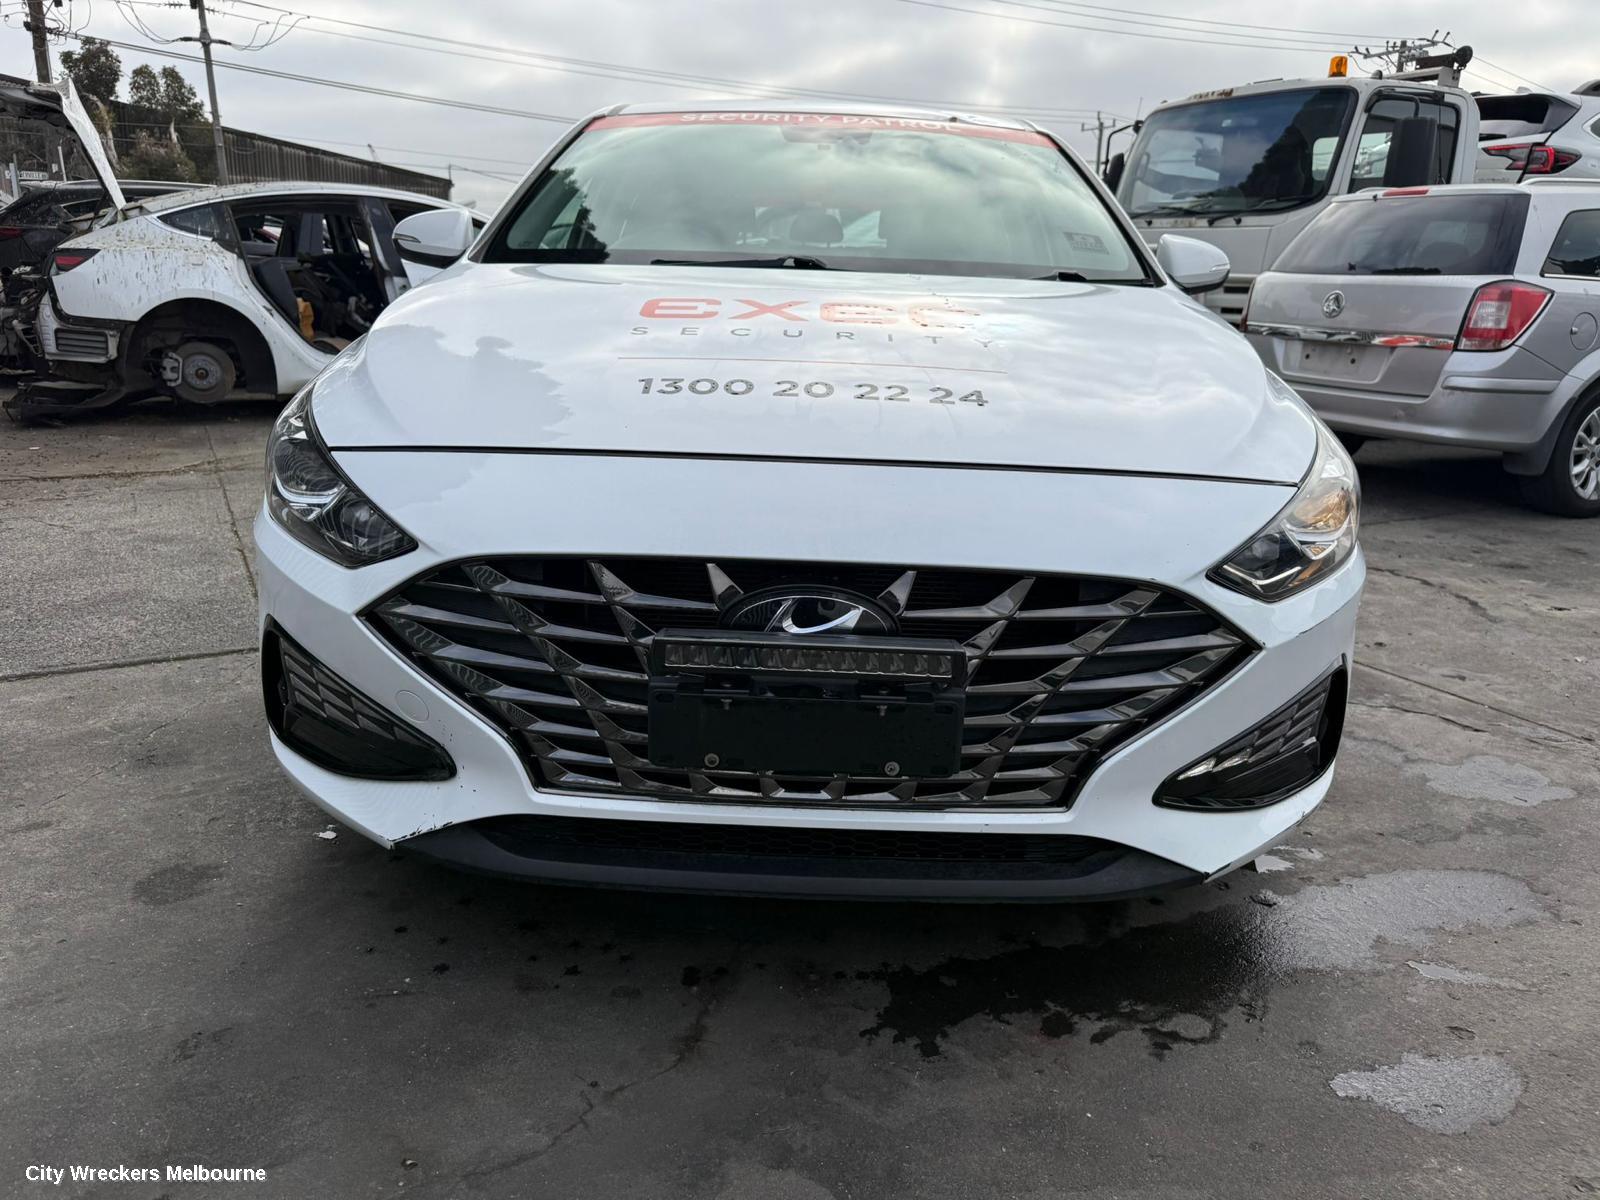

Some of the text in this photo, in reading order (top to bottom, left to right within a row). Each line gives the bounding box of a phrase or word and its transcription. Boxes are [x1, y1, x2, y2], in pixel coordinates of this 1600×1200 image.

[680, 111, 961, 132] SECURITY PATROL
[630, 326, 993, 348] SECURITY
[638, 377, 989, 407] 1300 20 22 24
